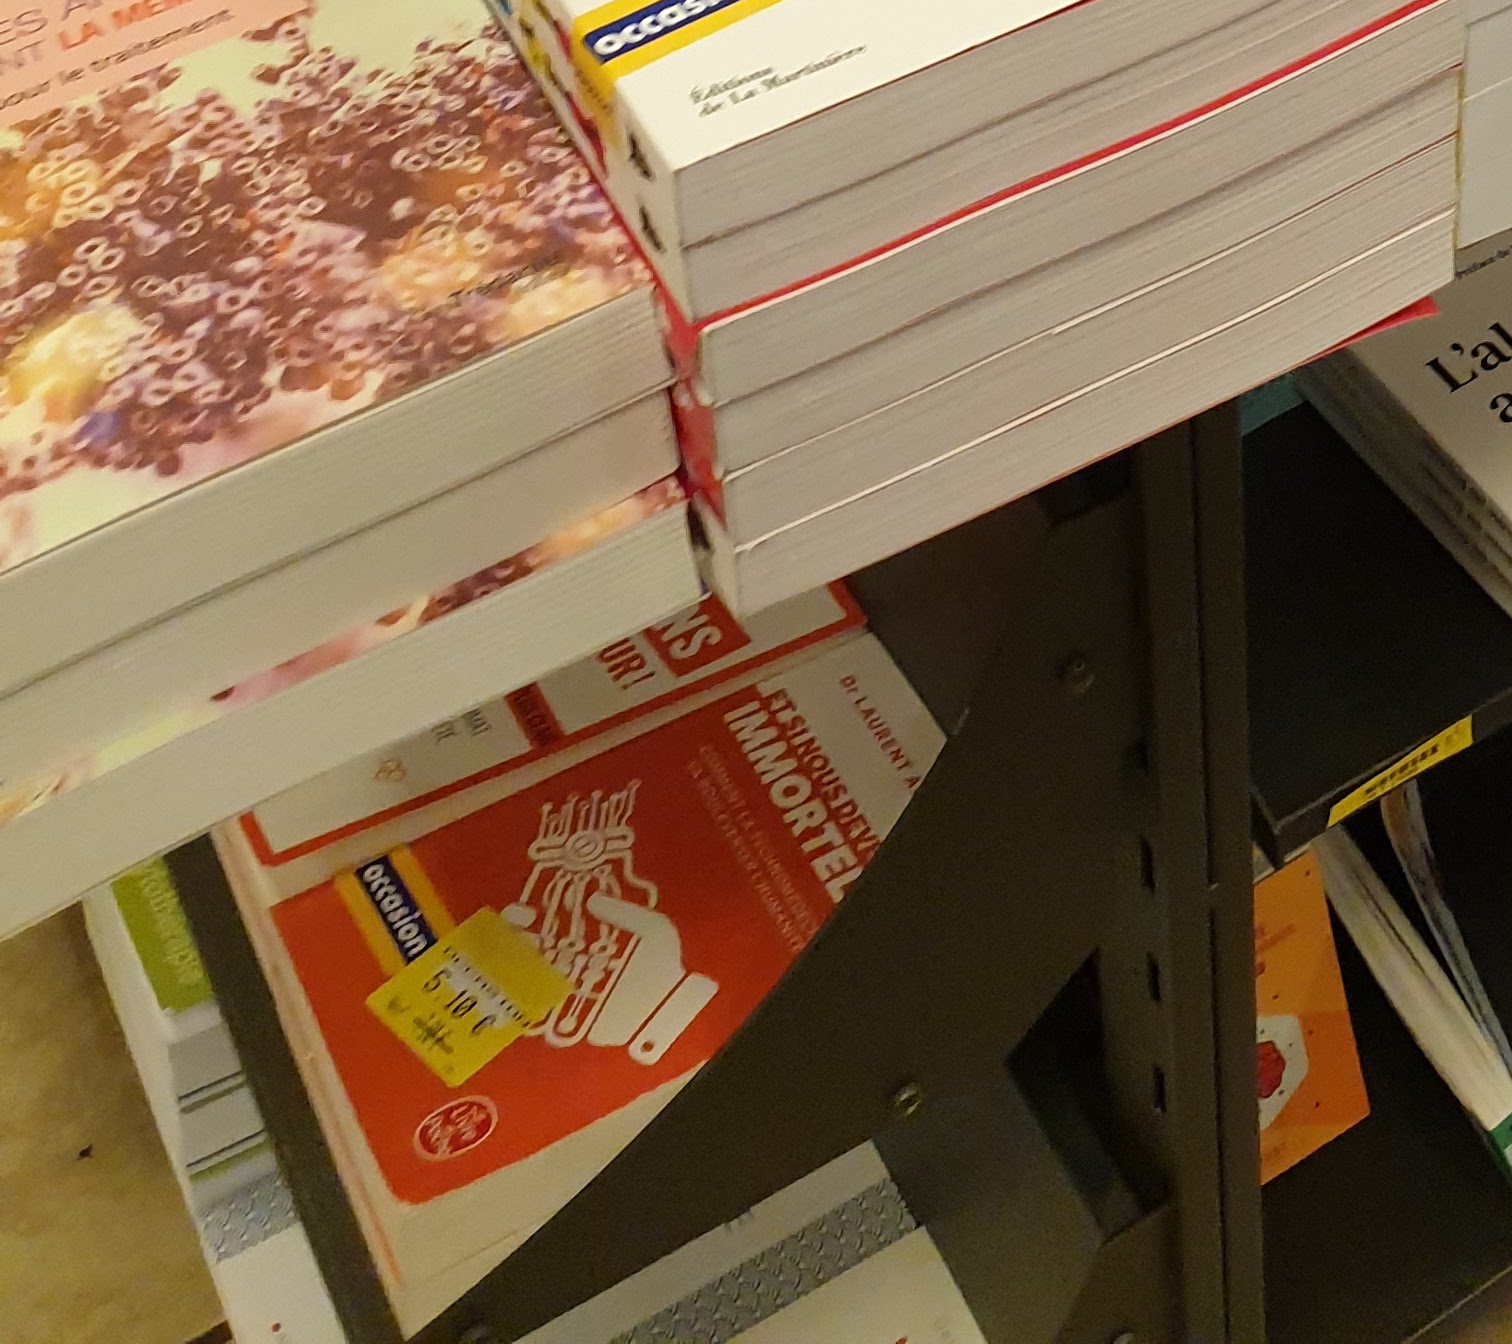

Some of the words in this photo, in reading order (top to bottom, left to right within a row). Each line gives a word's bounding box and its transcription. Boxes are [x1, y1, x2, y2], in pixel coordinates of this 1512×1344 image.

[57, 20, 104, 51] LA
[840, 675, 858, 693] Dr
[854, 696, 910, 771] LAURENT
[362, 864, 429, 959] occasion
